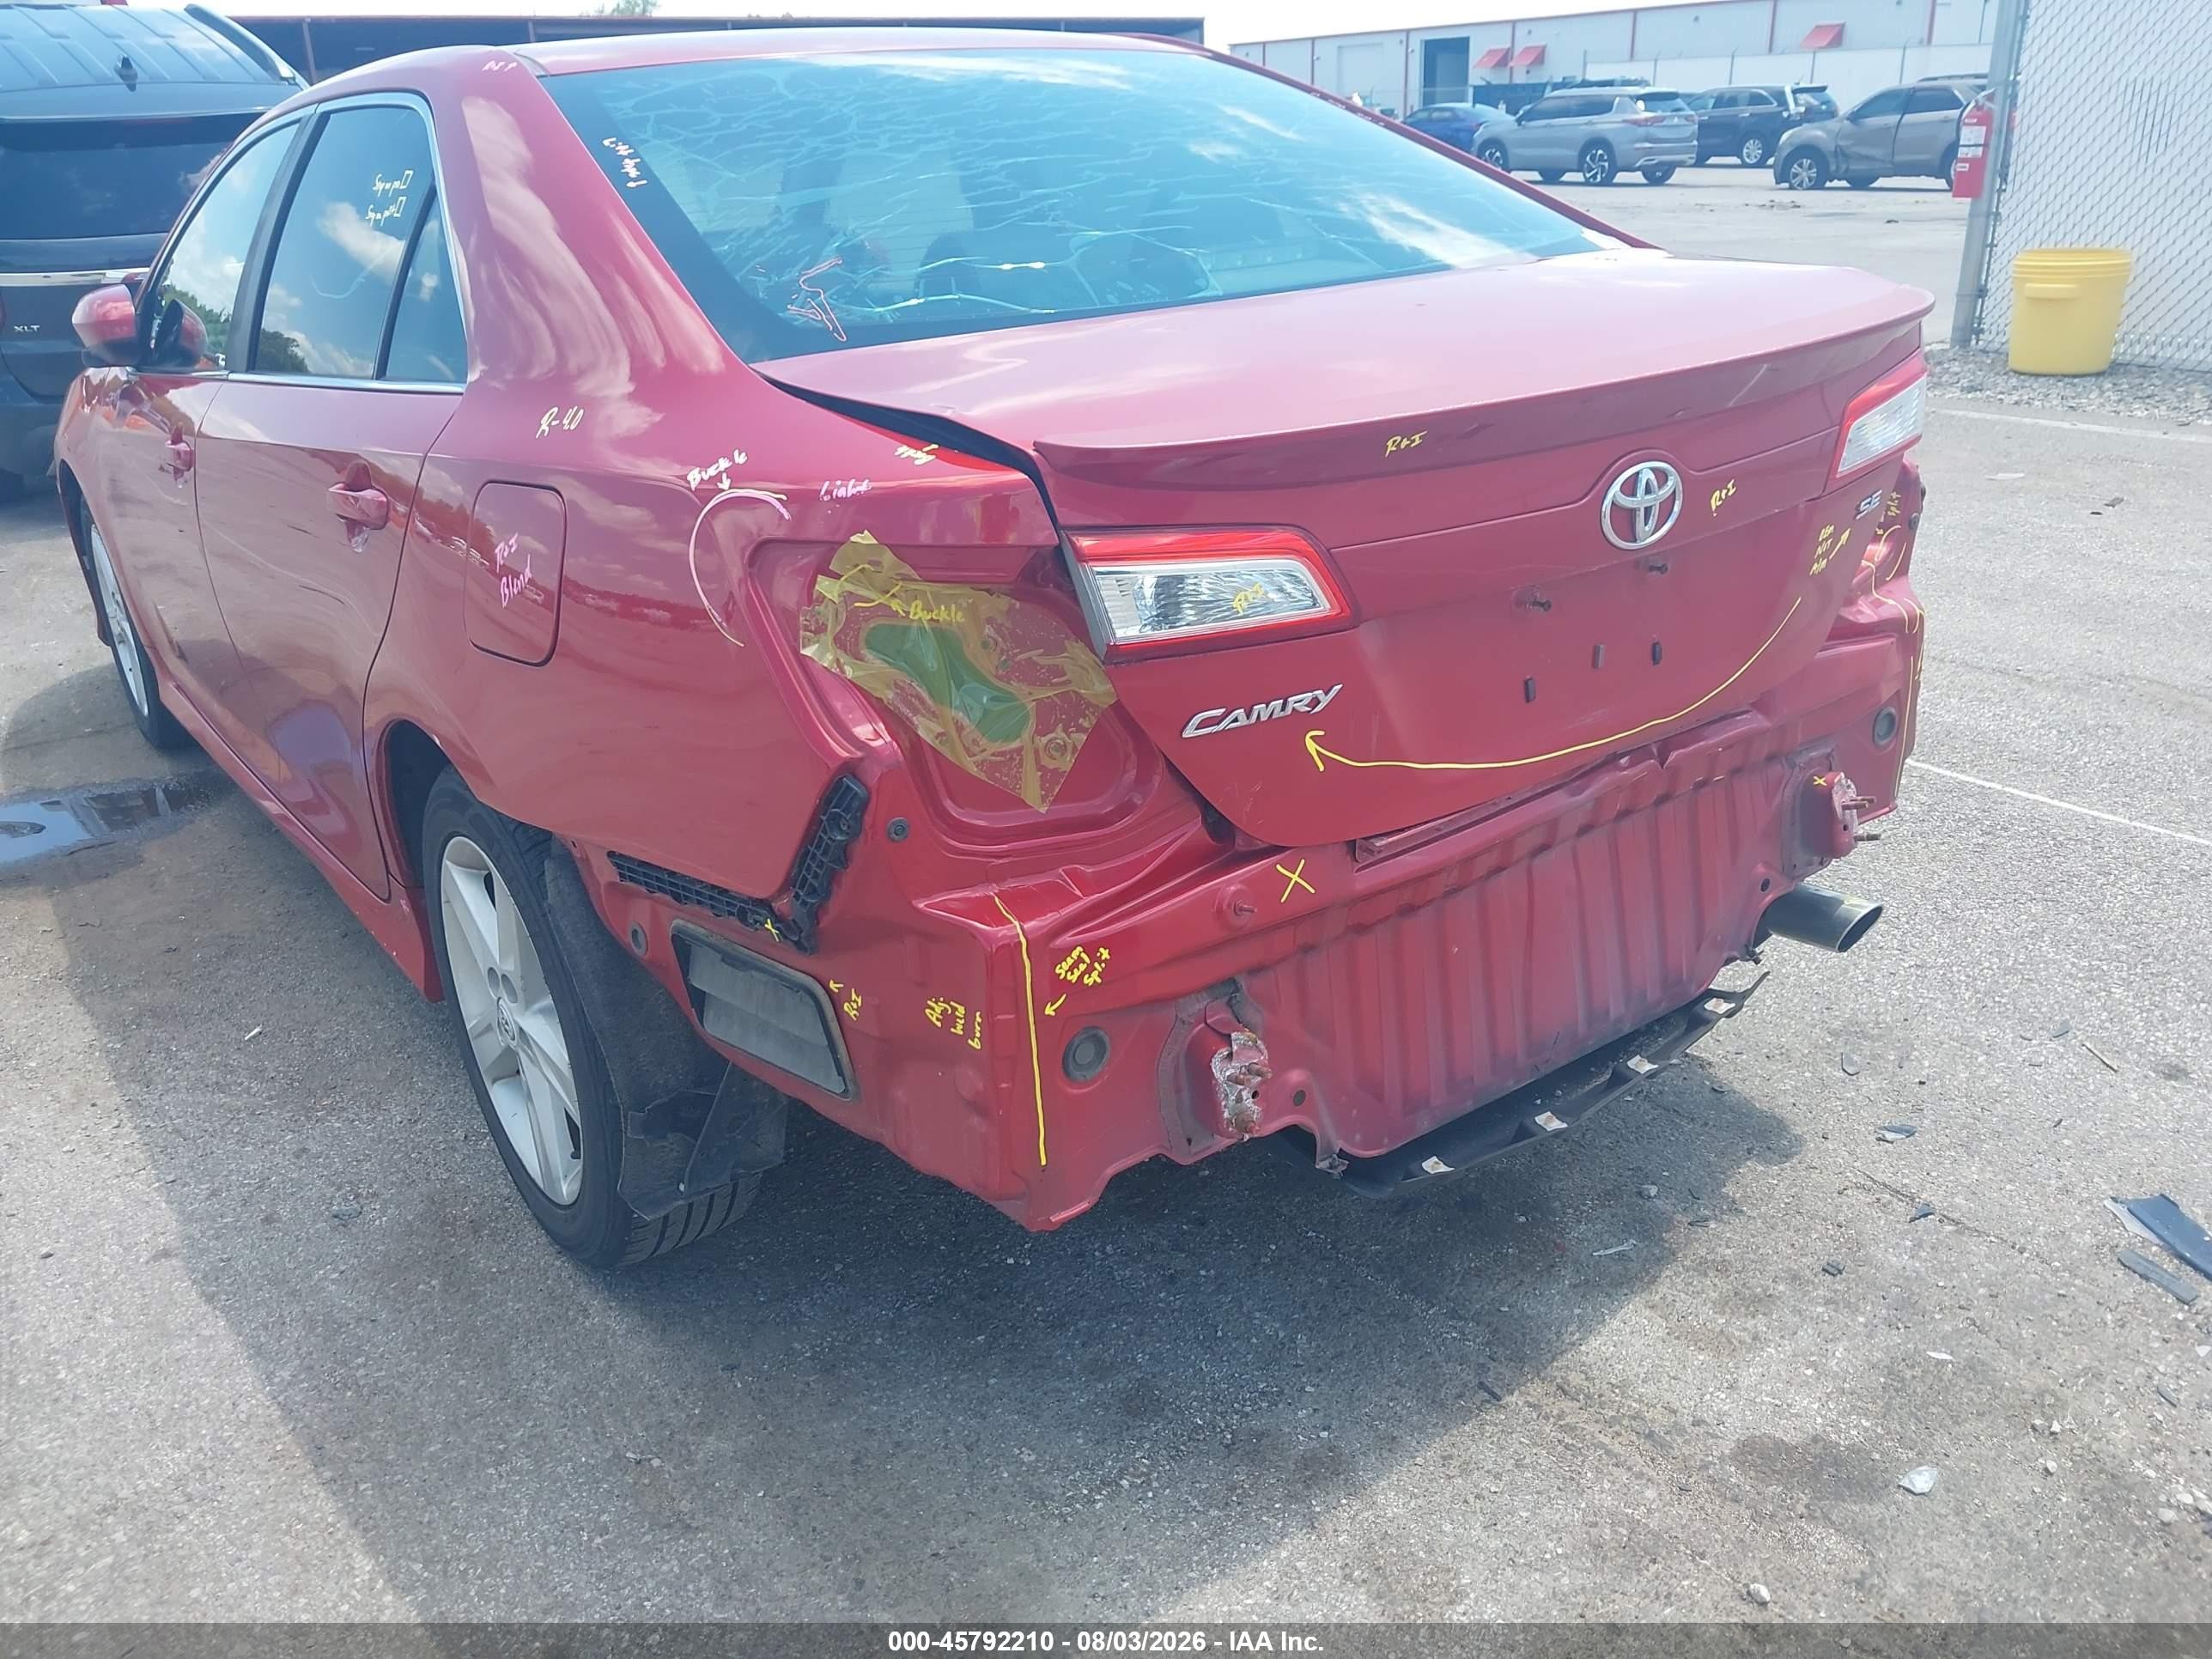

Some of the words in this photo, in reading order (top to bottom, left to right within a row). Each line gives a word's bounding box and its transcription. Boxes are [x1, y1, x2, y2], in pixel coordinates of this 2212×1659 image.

[1856, 489, 1882, 520] SE
[910, 600, 965, 623] Buckle
[1182, 684, 1343, 738] CAMRY
